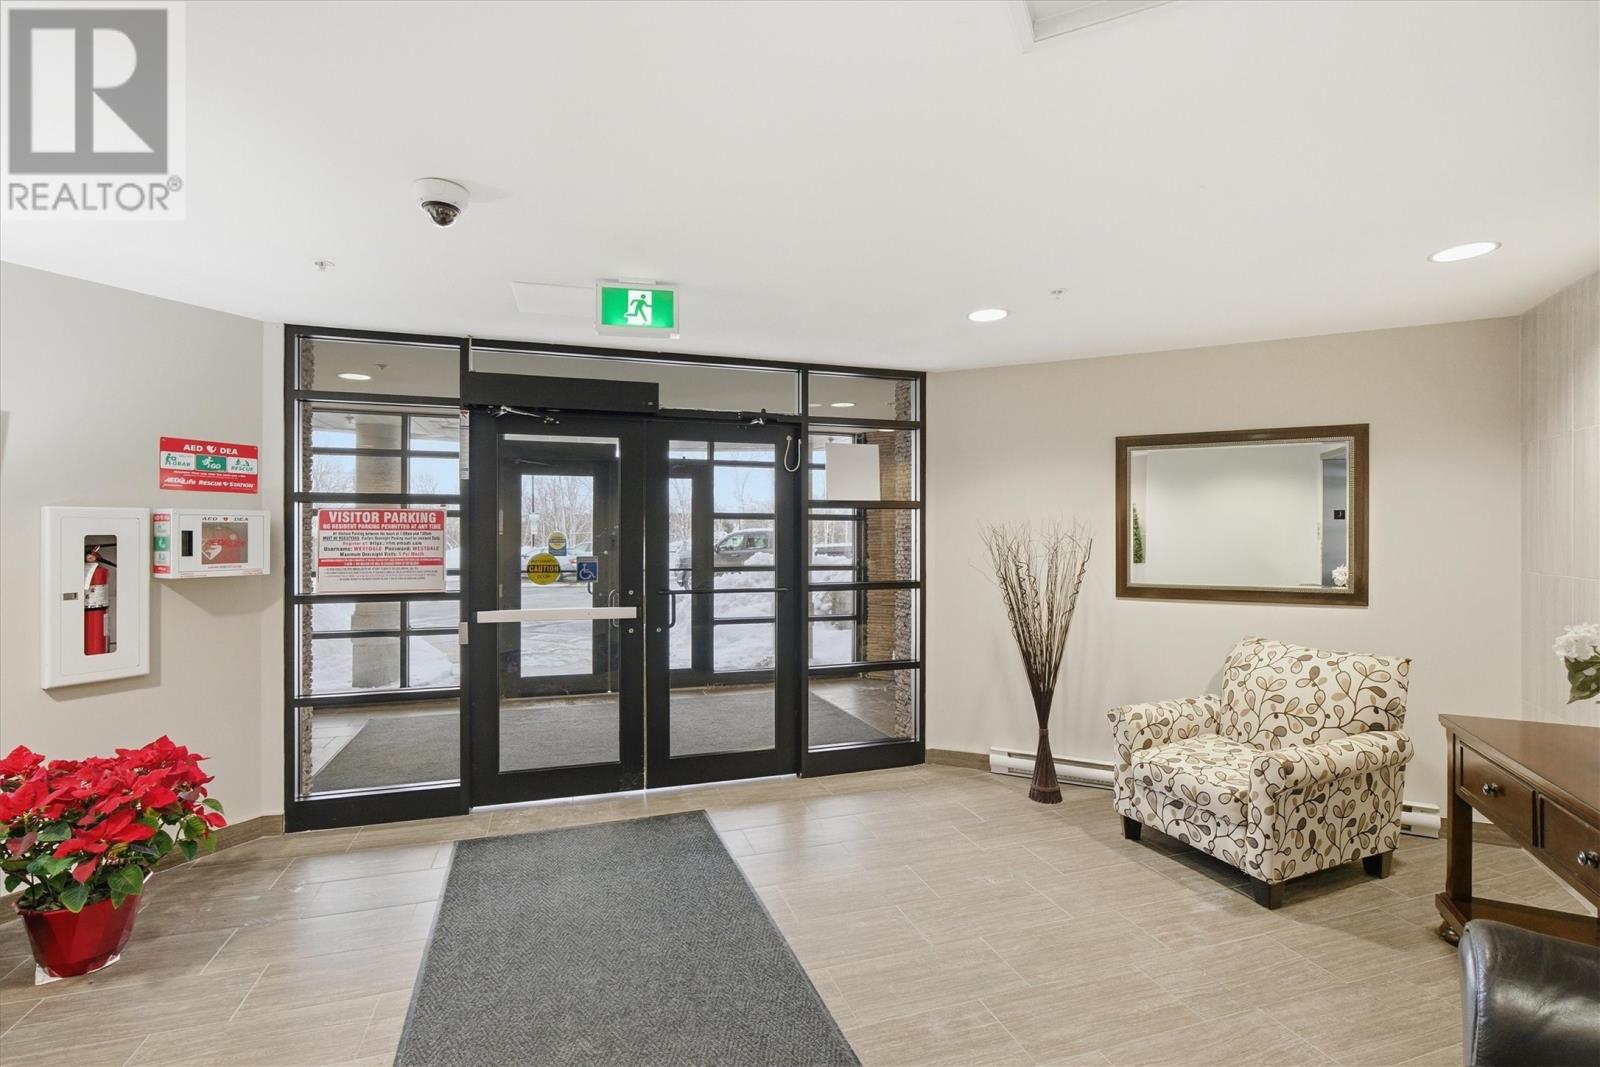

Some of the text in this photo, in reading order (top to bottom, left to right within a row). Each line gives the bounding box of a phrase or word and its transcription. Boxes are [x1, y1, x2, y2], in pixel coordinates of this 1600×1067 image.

[184, 444, 203, 452] AED
[328, 511, 437, 523] VISITOR PARKING
